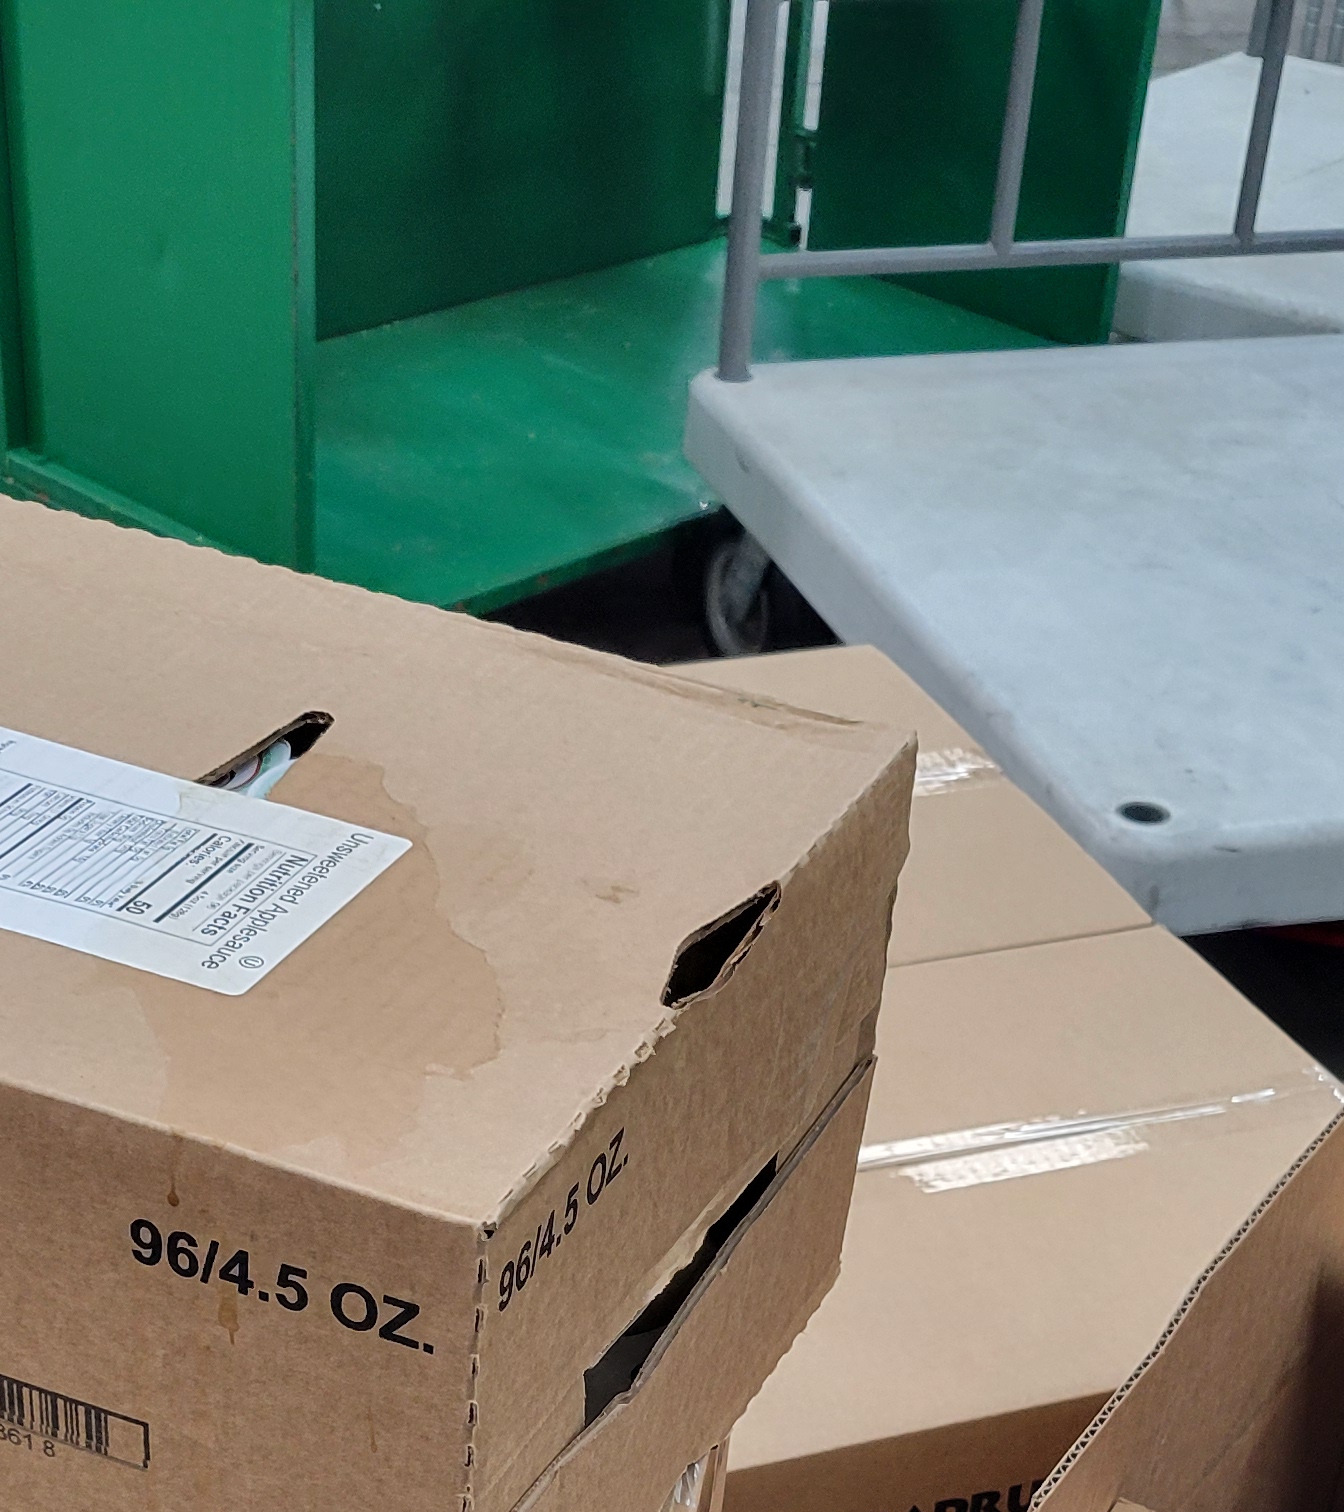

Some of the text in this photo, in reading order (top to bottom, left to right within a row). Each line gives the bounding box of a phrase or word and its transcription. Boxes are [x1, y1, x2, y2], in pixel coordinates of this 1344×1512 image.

[198, 854, 310, 937] Nutrition Facts
[276, 831, 375, 904] Unsweetened
[122, 899, 154, 915] 50
[194, 901, 292, 971] Applesauce
[498, 1126, 629, 1312] 96/4.5 OZ.
[130, 1219, 435, 1354] 96/4.5 OZ.
[43, 1440, 56, 1457] 8
